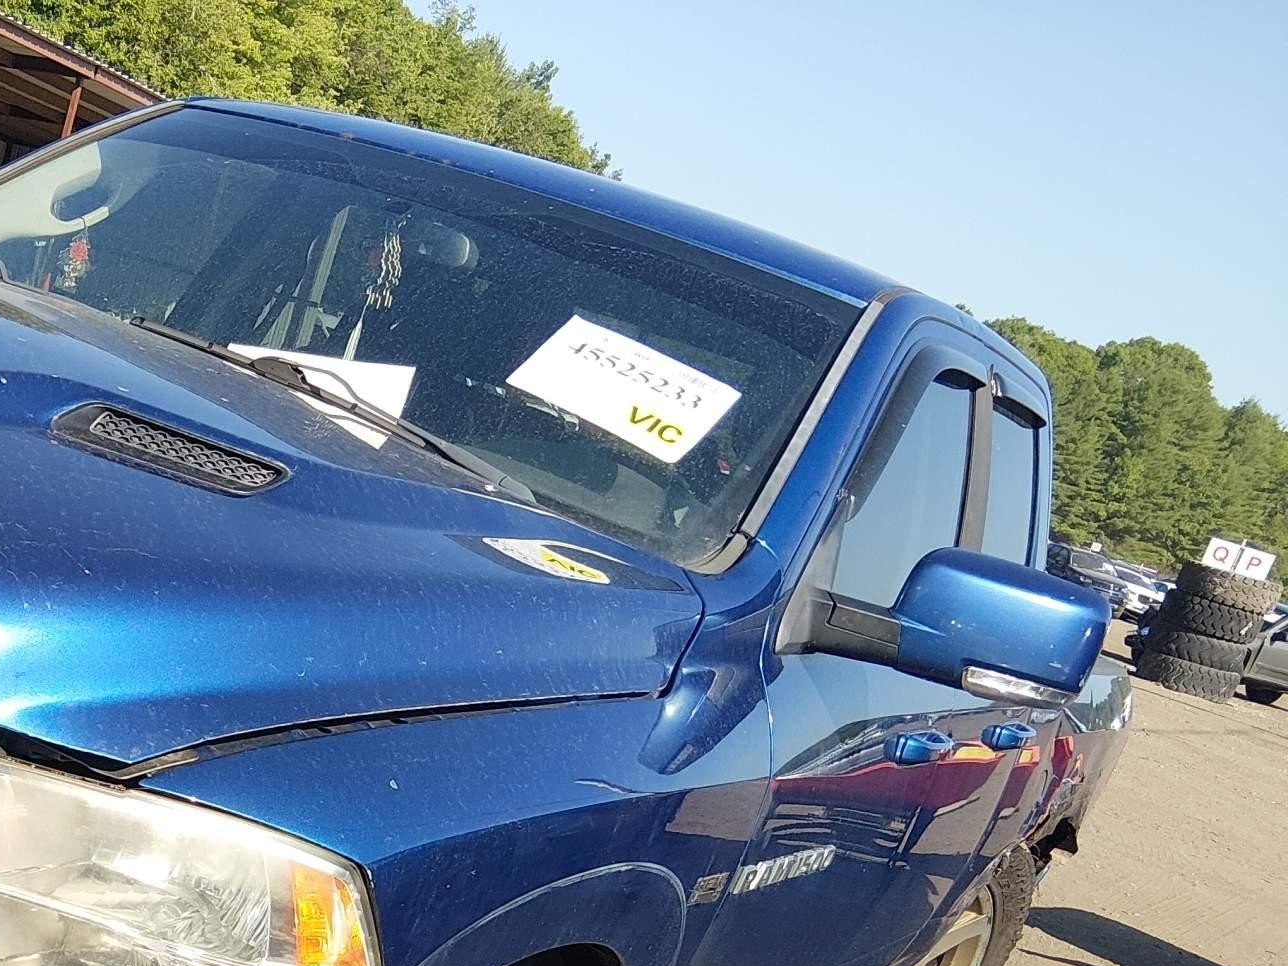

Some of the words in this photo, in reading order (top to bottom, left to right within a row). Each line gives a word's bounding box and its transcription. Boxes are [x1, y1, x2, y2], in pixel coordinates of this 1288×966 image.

[568, 343, 703, 410] 45525233
[629, 405, 684, 444] VIC
[1212, 545, 1230, 564] Q
[1245, 556, 1262, 571] P
